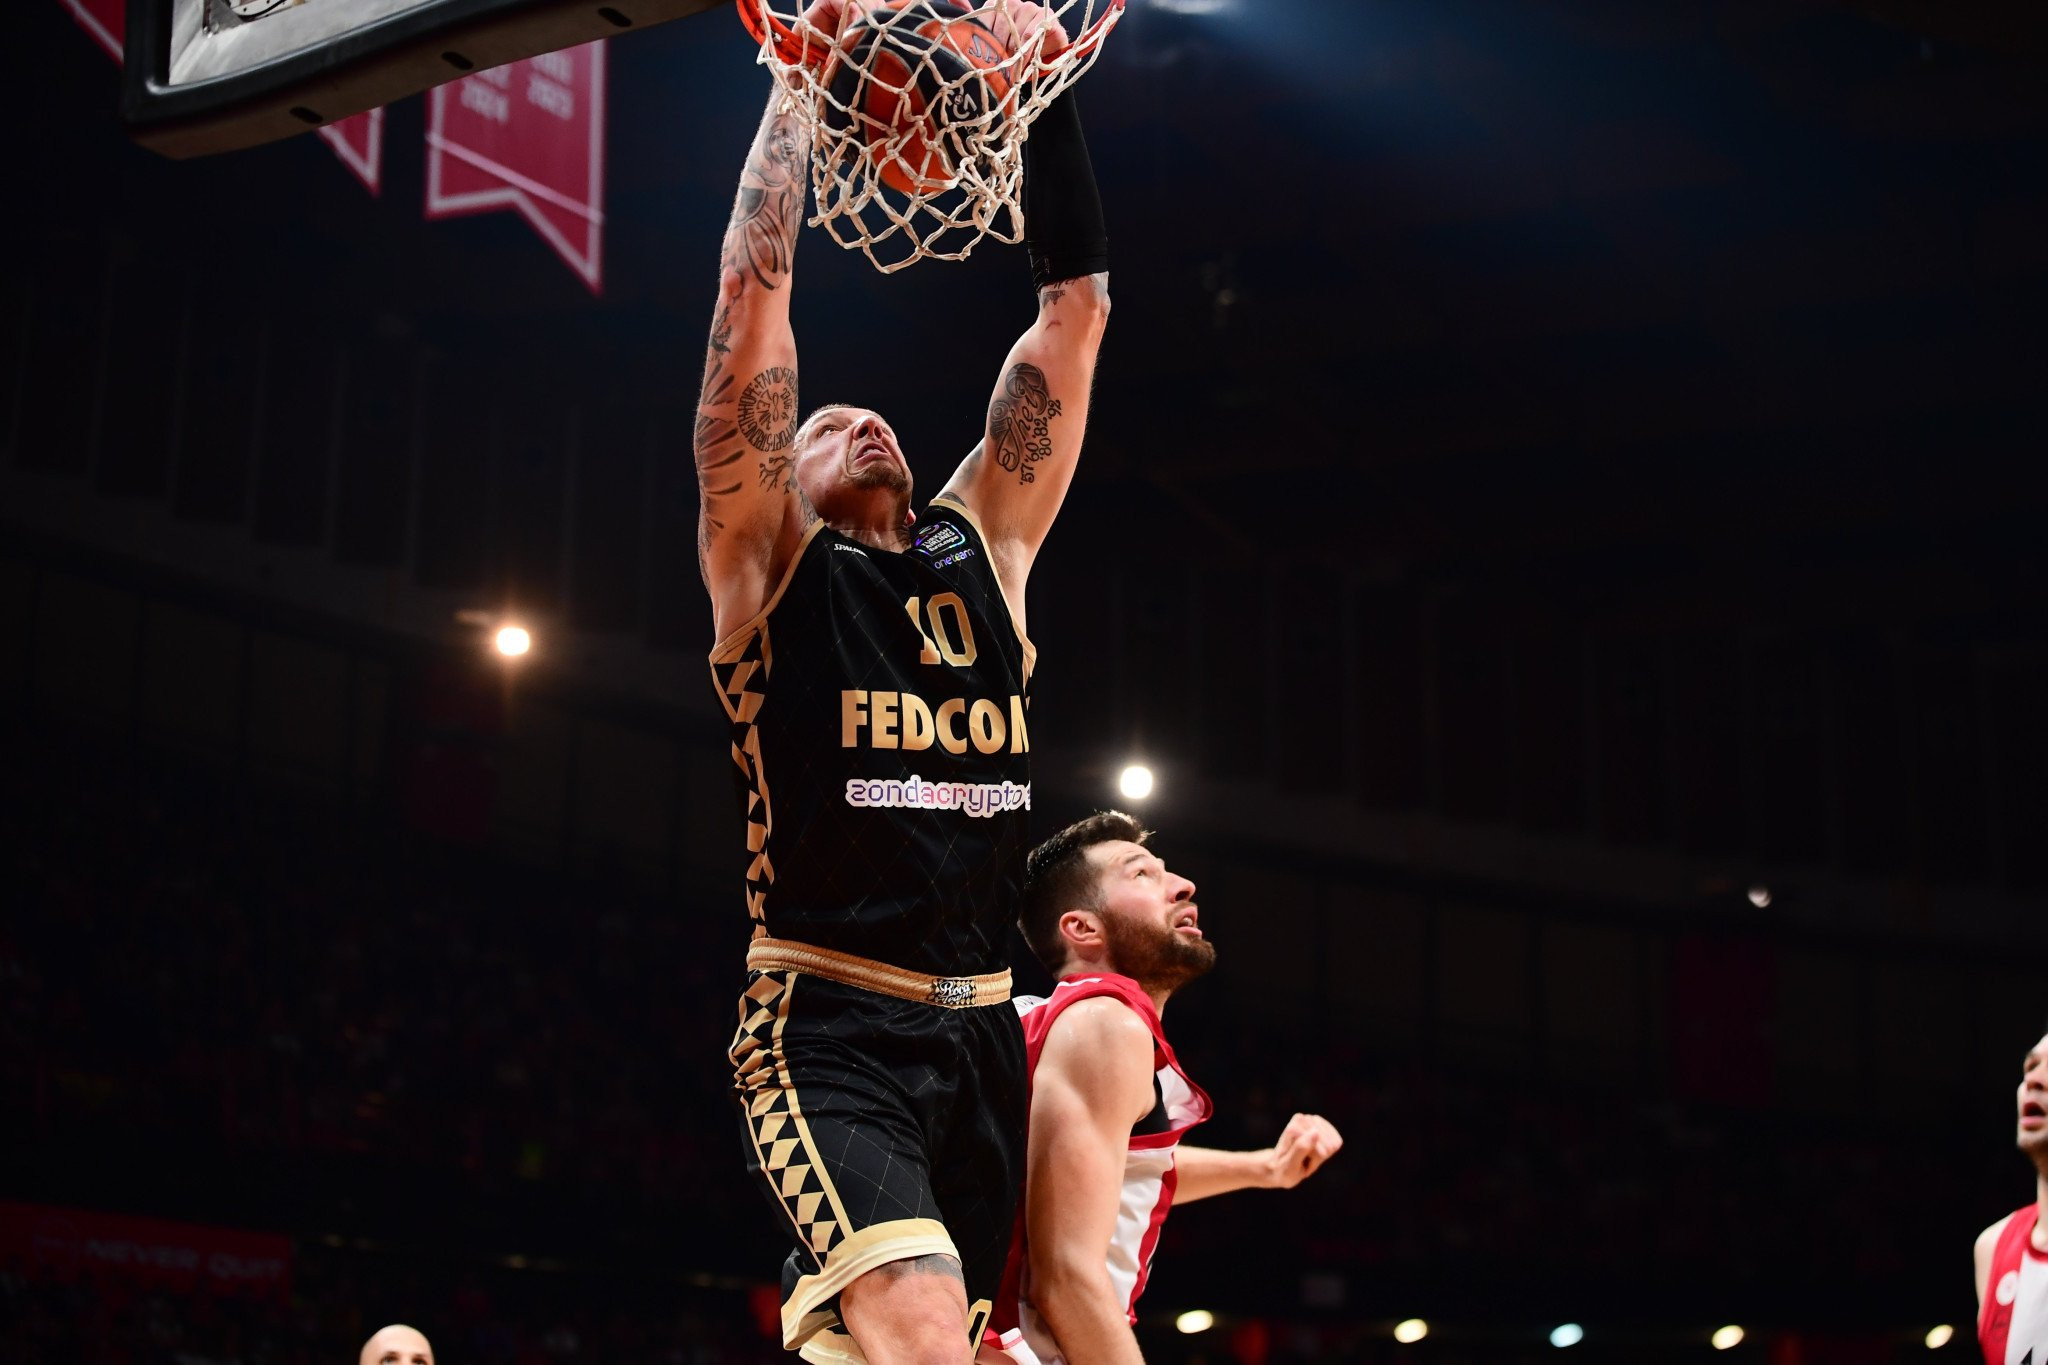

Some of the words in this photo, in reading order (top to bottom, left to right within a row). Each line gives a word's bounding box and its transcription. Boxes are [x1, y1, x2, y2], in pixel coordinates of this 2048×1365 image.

[921, 527, 951, 546] TURKISH
[925, 531, 956, 549] AIRLINES
[934, 548, 975, 569] oneteam
[904, 591, 978, 667] 10
[849, 777, 1023, 814] zondacrypto
[940, 981, 971, 996] Roca
